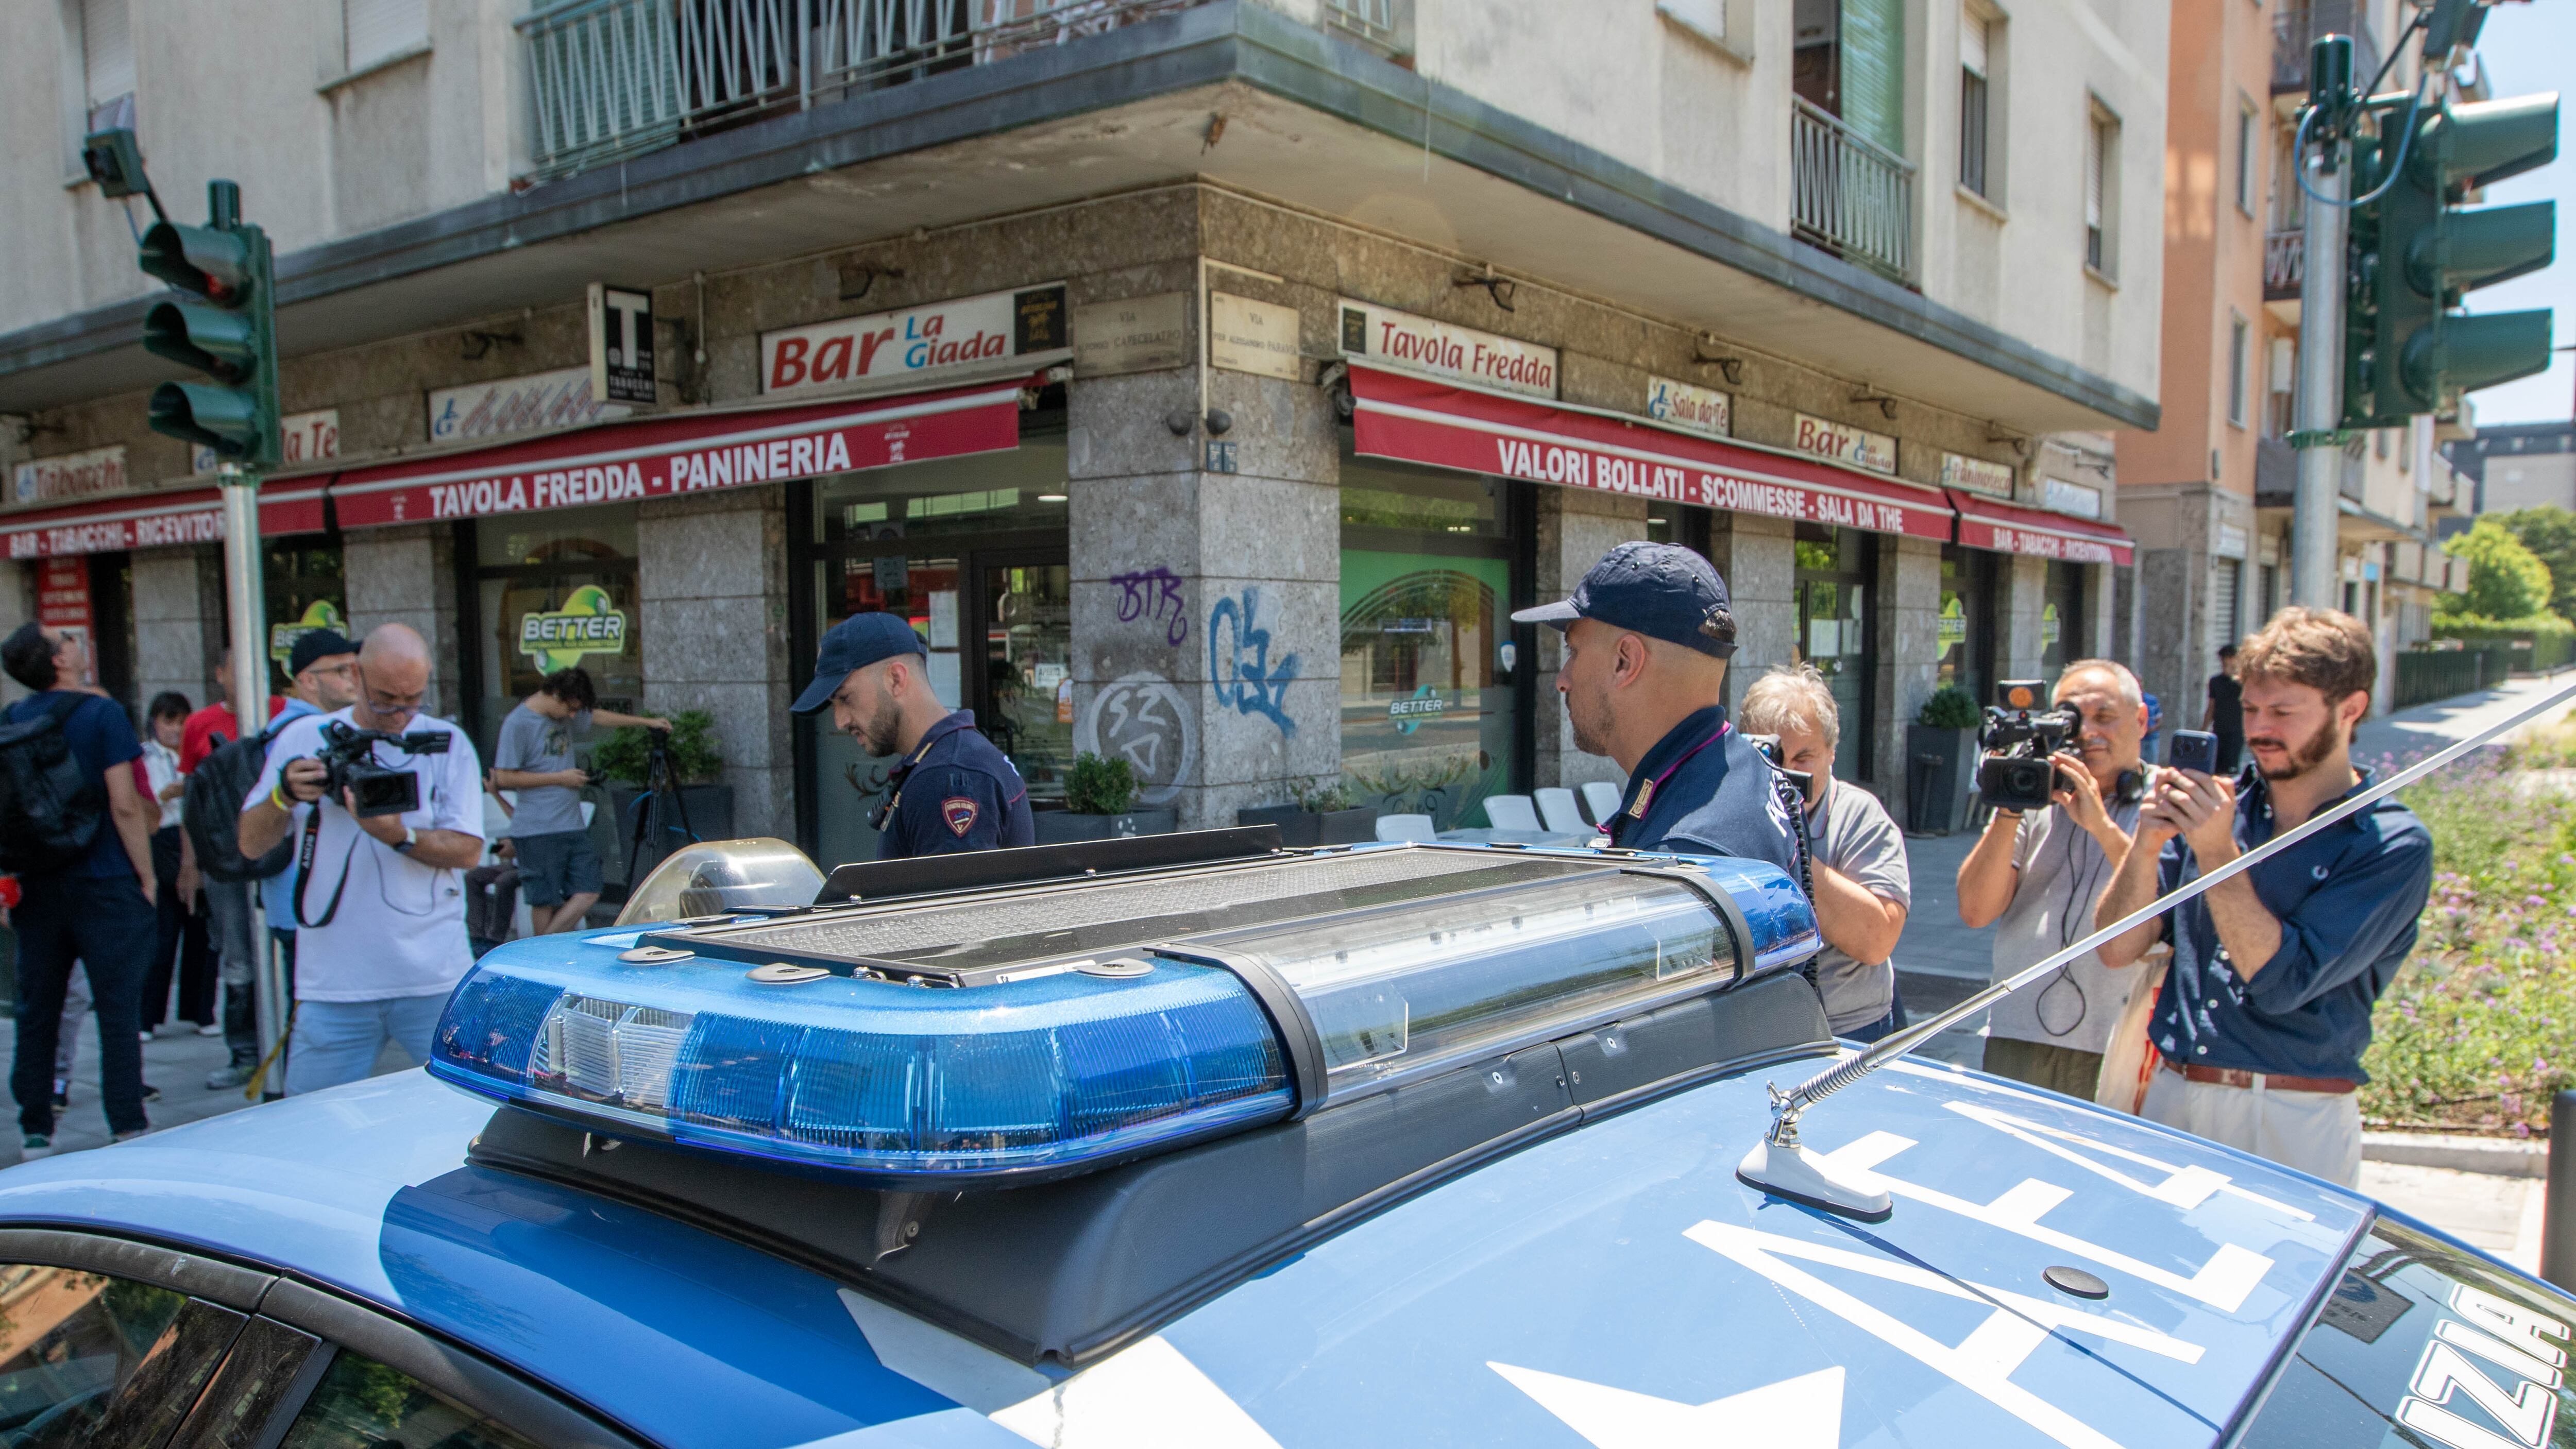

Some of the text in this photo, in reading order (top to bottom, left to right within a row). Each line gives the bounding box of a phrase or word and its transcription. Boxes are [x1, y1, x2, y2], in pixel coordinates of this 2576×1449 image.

[606, 289, 649, 368] T
[905, 314, 944, 341] La
[1119, 311, 1136, 323] VIA
[1249, 312, 1264, 327] VIA
[770, 327, 895, 390] Bar
[905, 330, 1006, 369] Giada
[1380, 321, 1463, 370] Tavola
[1471, 343, 1553, 389] Fredda
[1672, 391, 1696, 420] Sala
[1699, 399, 1712, 423] da
[1714, 403, 1727, 428] Te
[312, 420, 337, 461] Te
[1797, 419, 1849, 457] Bar
[429, 477, 527, 519] TAVOLA
[533, 463, 646, 508] FREDDA
[670, 432, 852, 491] PANINERIA
[1497, 438, 1589, 486] VALORI
[1596, 455, 1685, 500] BOLLATI
[1701, 474, 1806, 518] SCOMMESSE
[1817, 493, 1854, 525] SALA
[1857, 501, 1875, 528] DA
[1876, 504, 1904, 532] THE
[10, 531, 38, 558] BAR
[50, 521, 124, 555] TABACCHI
[1993, 526, 2013, 551] BAR
[2018, 531, 2060, 556] TABACCHI
[524, 616, 621, 641] BETTER
[1391, 699, 1443, 715] BETTER
